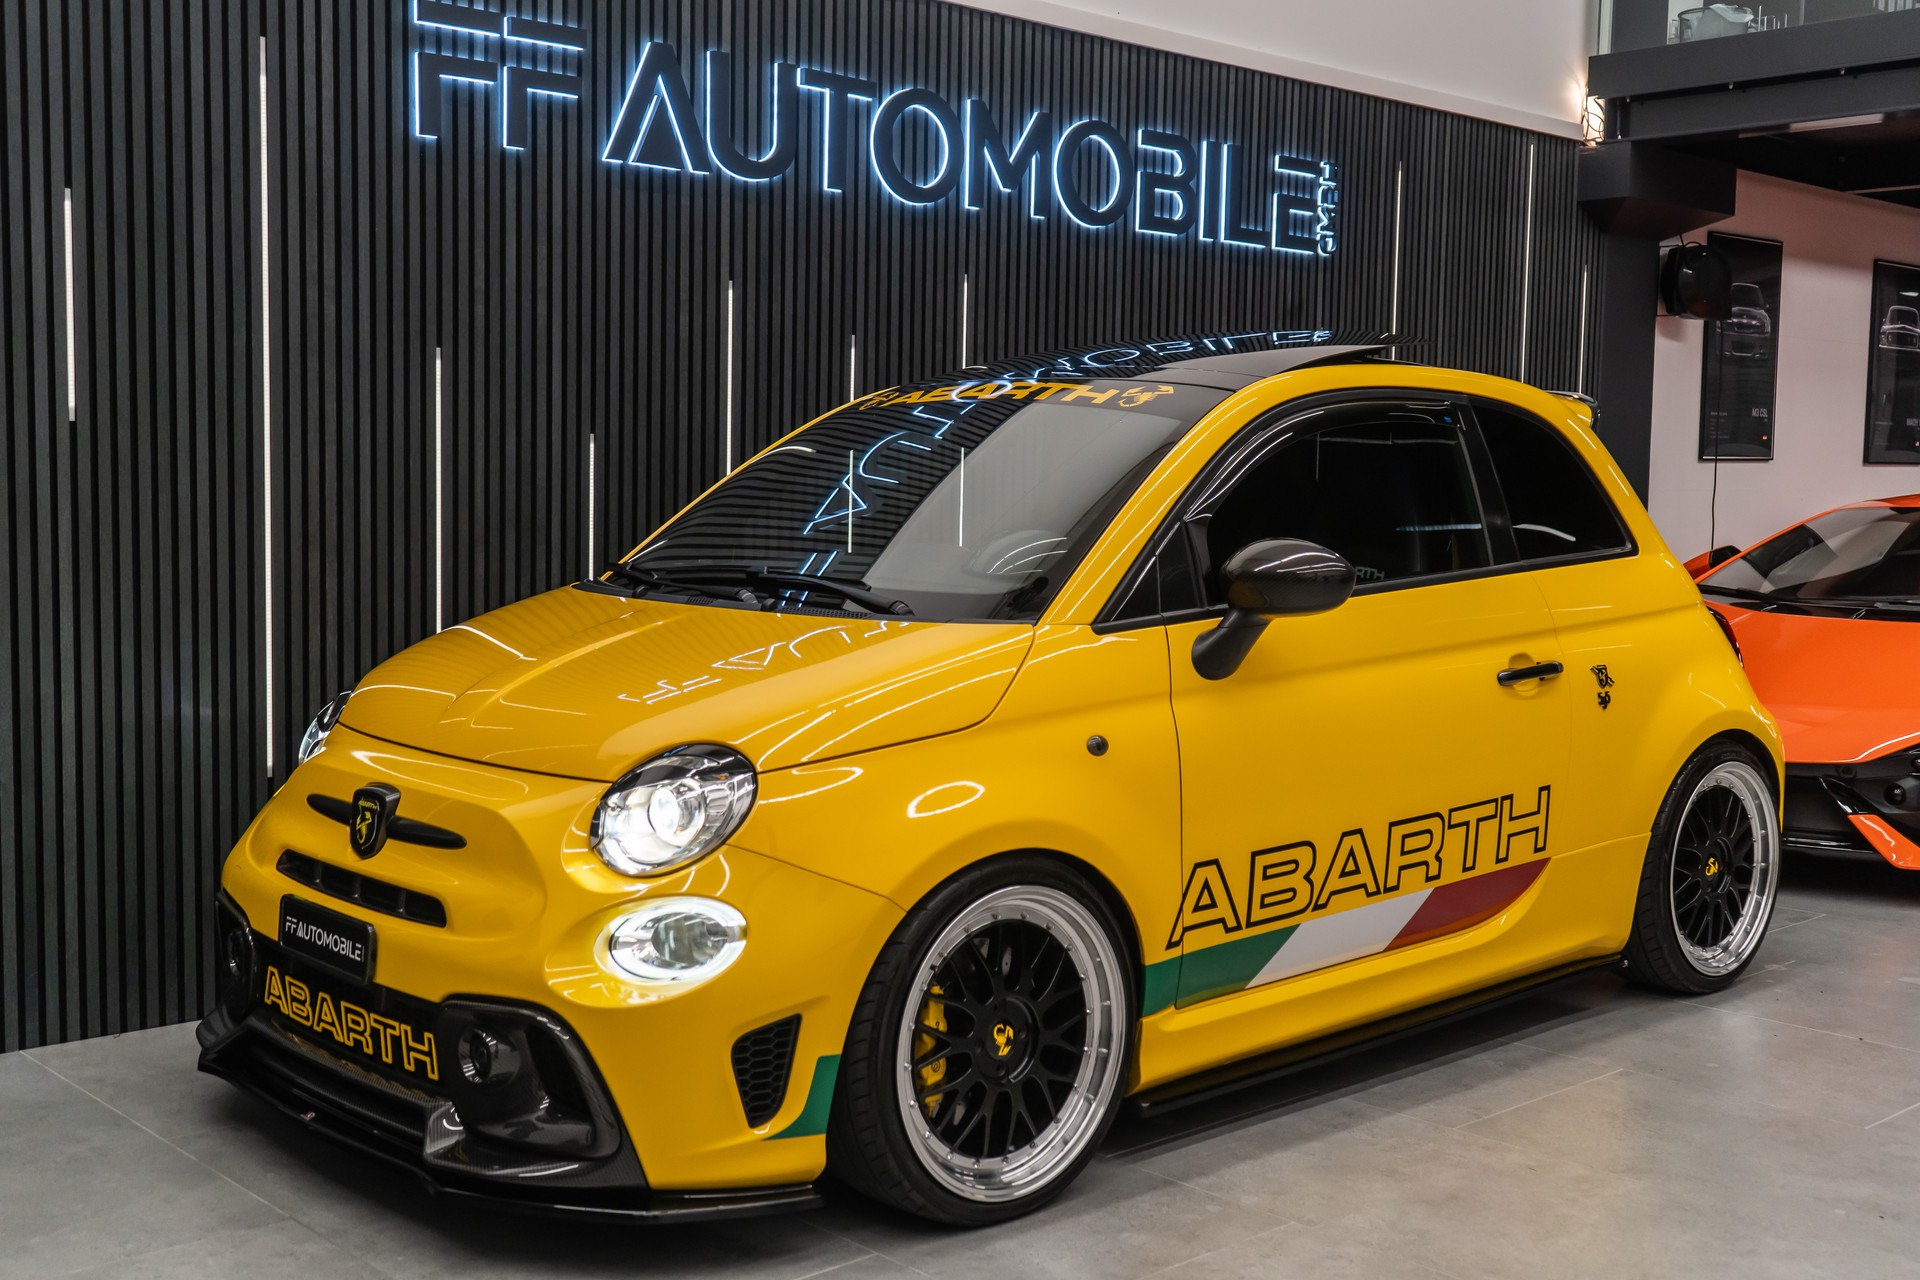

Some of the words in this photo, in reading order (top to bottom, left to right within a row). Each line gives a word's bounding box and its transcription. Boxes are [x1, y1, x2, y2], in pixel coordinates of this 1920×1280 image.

[879, 381, 1121, 407] ABARTH
[1165, 784, 1551, 950] ABARTH
[263, 964, 440, 1082] ABARTH
